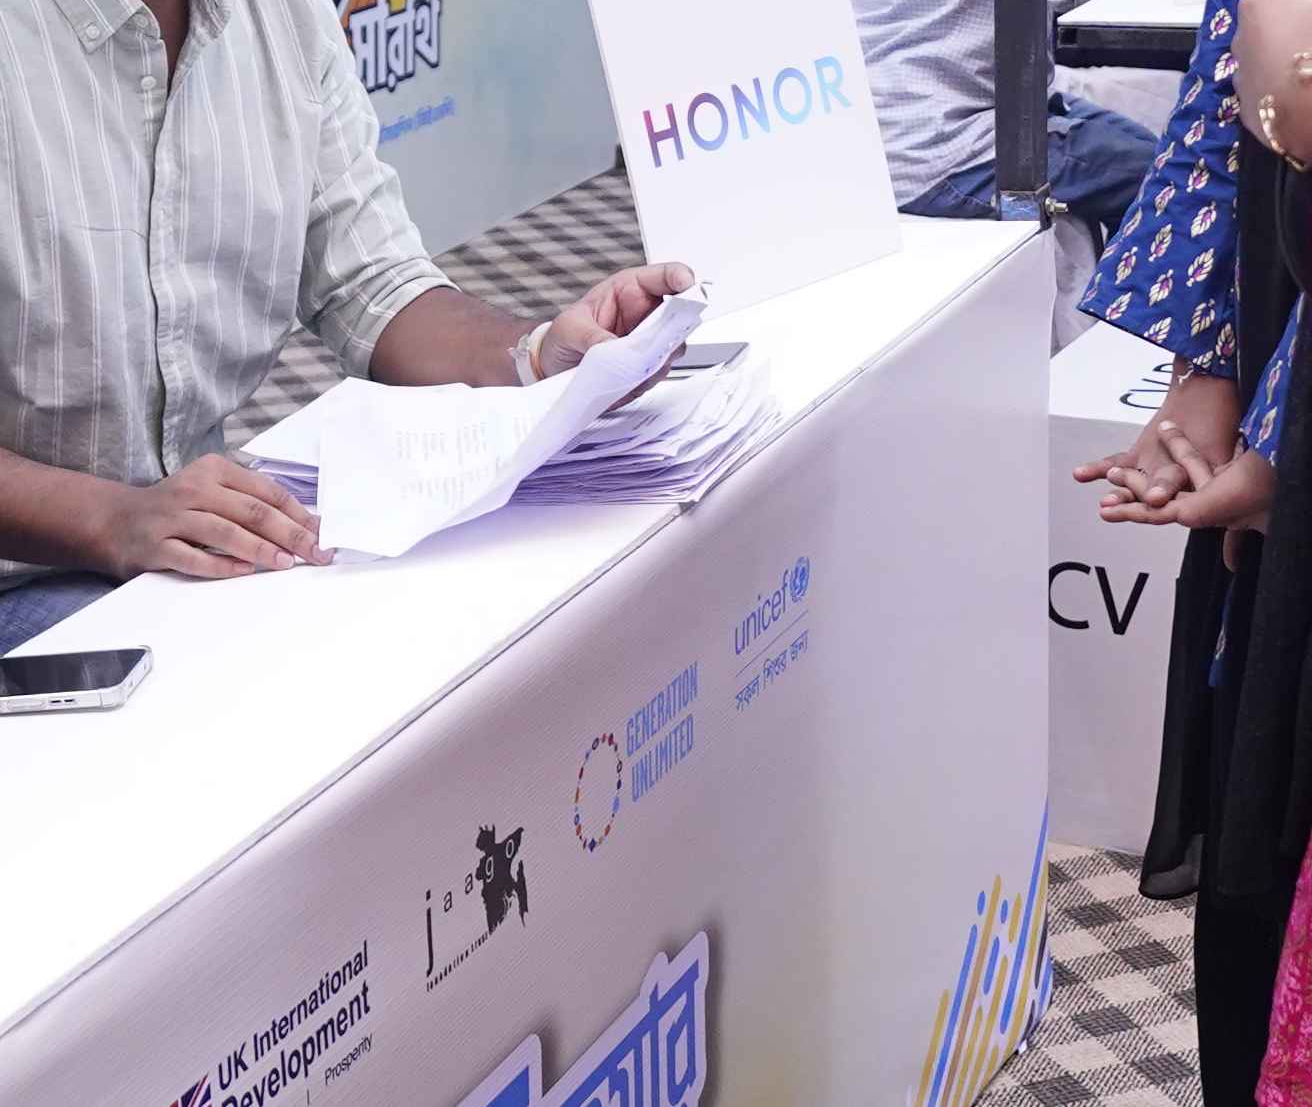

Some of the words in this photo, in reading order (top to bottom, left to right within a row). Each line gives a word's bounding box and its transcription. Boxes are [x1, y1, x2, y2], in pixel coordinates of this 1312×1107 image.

[642, 55, 852, 169] HONOR
[735, 569, 788, 655] unicef
[626, 660, 698, 758] GENERATION
[631, 713, 694, 803] UNLIMITED
[218, 1041, 249, 1091] UK
[252, 939, 369, 1063] International
[324, 1033, 373, 1085] Prosperity
